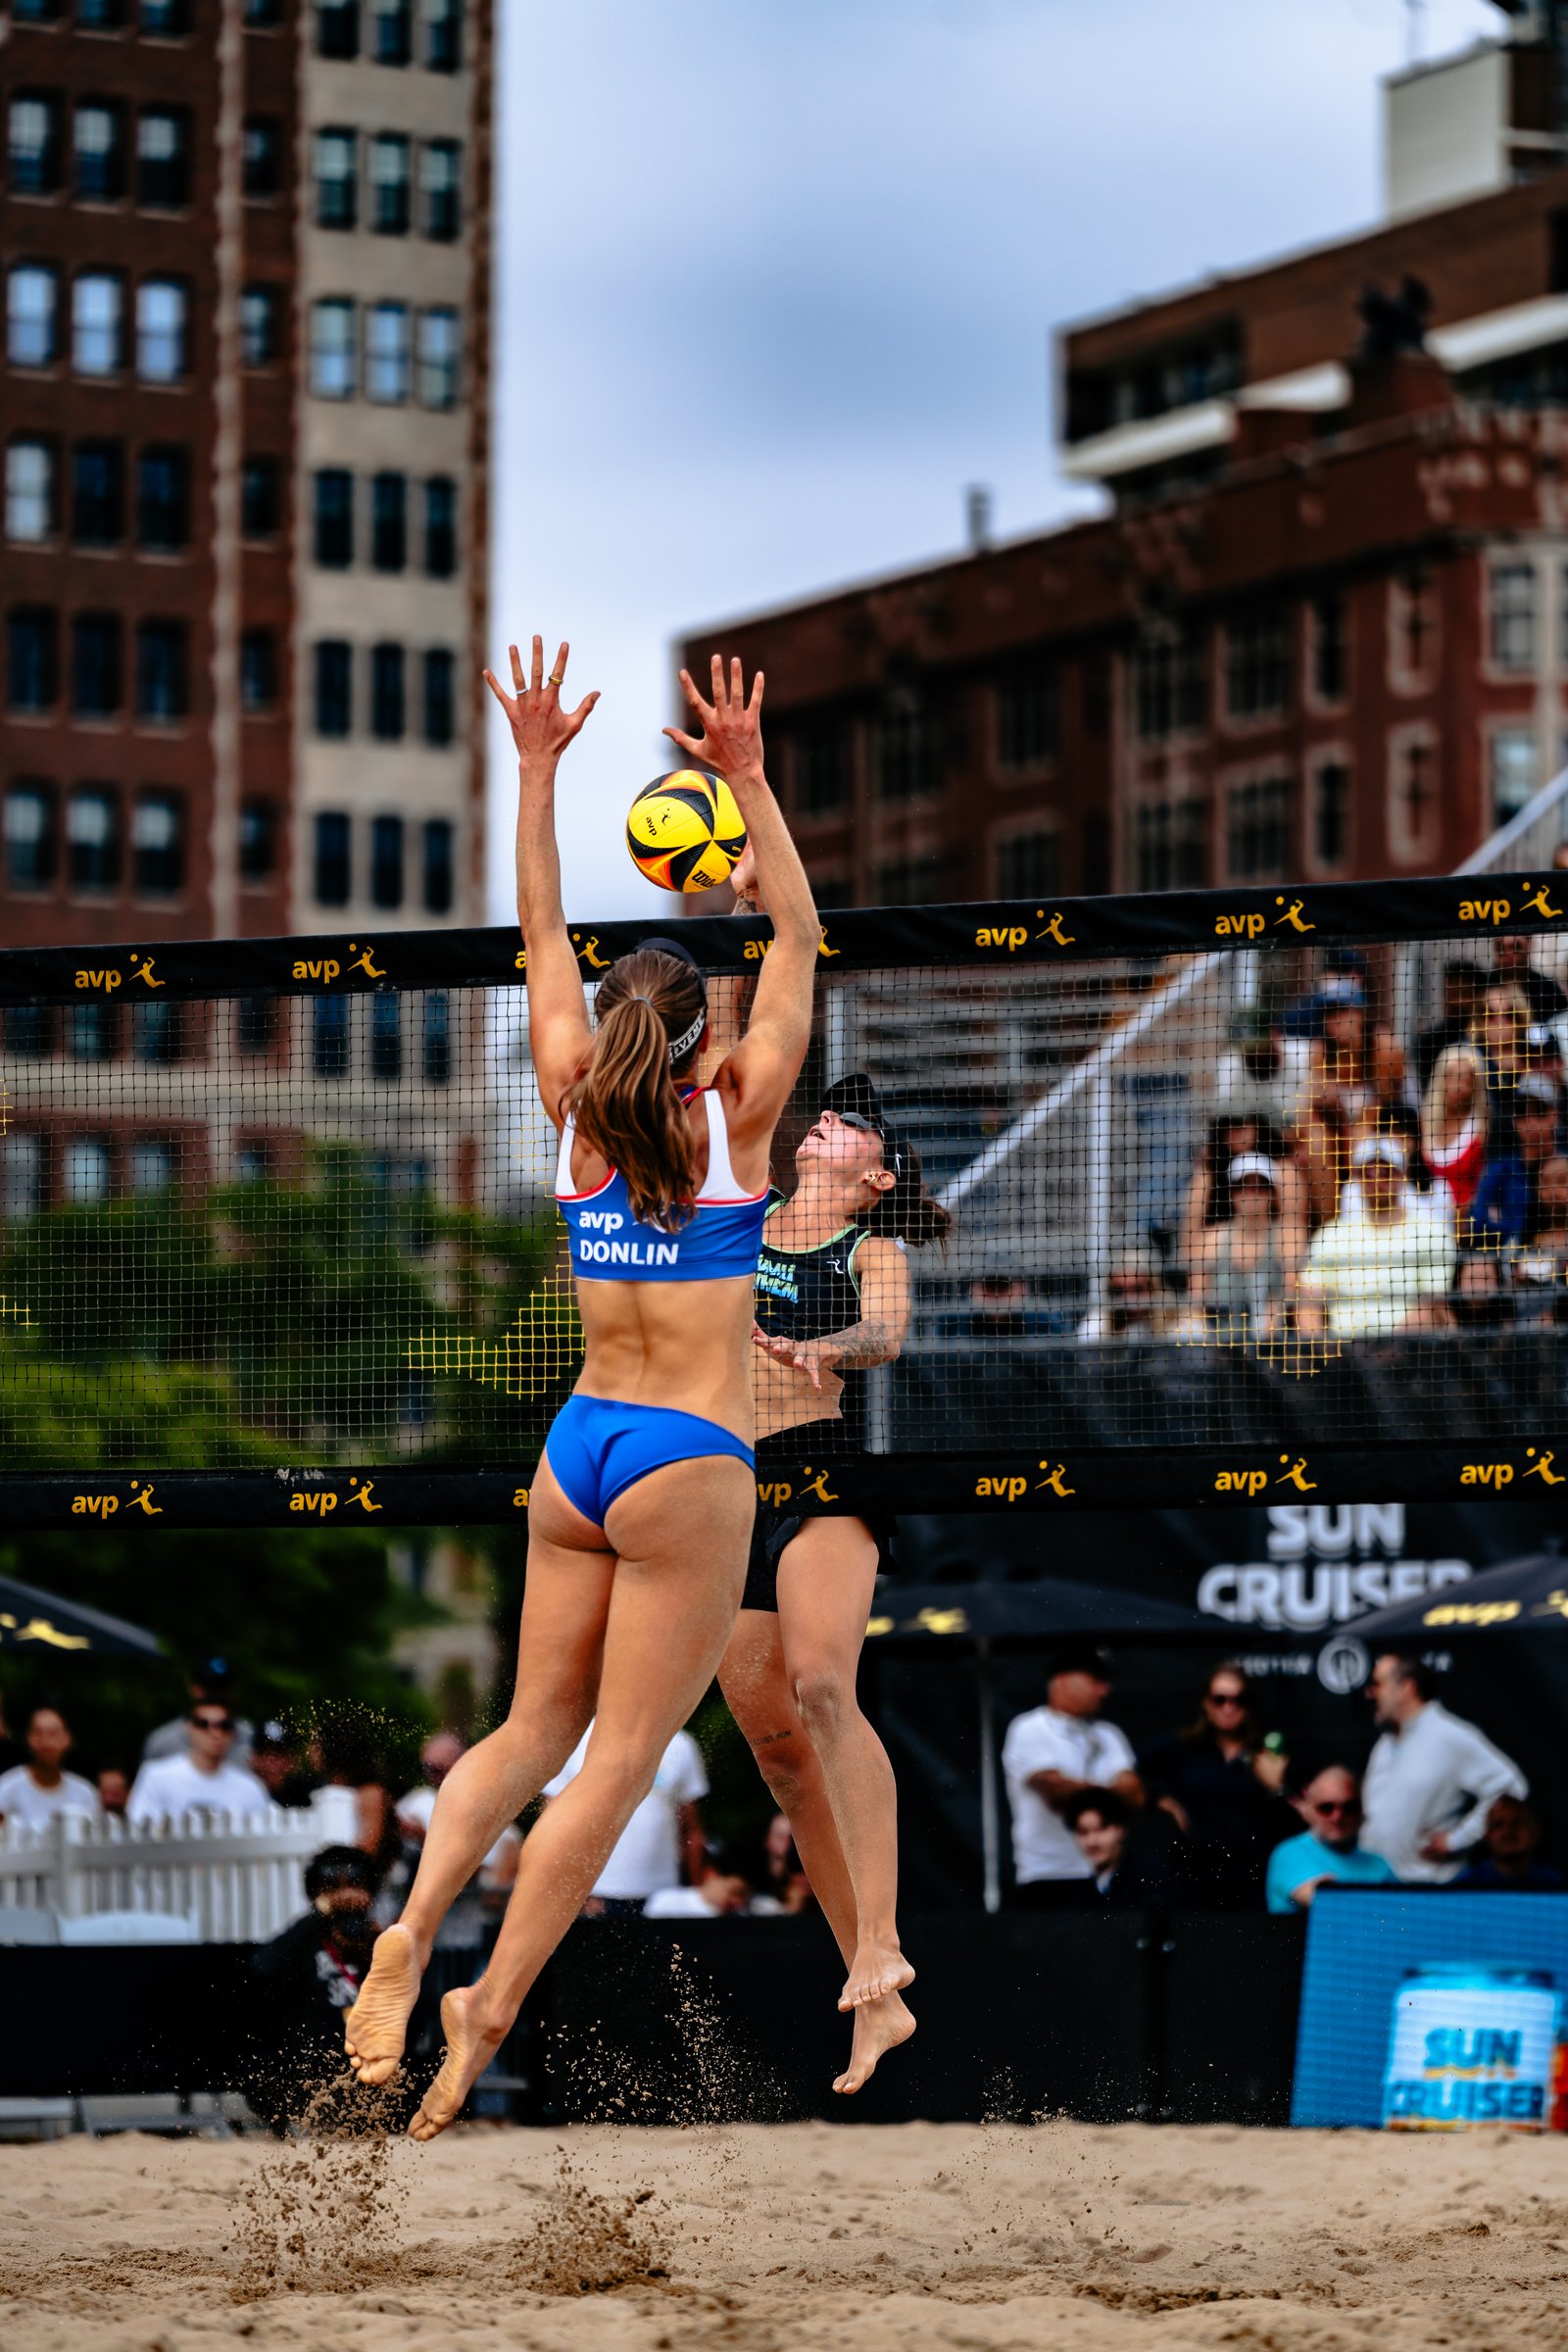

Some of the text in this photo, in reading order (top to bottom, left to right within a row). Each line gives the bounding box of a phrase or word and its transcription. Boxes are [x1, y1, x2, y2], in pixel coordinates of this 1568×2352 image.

[646, 816, 658, 836] avp
[1459, 899, 1511, 925] avp
[1215, 913, 1265, 939] avp
[743, 940, 775, 959] av
[976, 926, 1028, 952] avp
[74, 970, 122, 994] avp
[292, 959, 340, 984] avp
[579, 1211, 623, 1235] avp
[580, 1239, 679, 1265] DONLIN
[975, 1477, 1027, 1502] avp
[1215, 1470, 1268, 1496] avp
[1459, 1464, 1514, 1491] avp
[72, 1495, 120, 1520] avp
[289, 1493, 338, 1517] avp
[758, 1483, 792, 1507] vp
[1267, 1503, 1405, 1559] SUN
[1424, 2028, 1522, 2070] SUN
